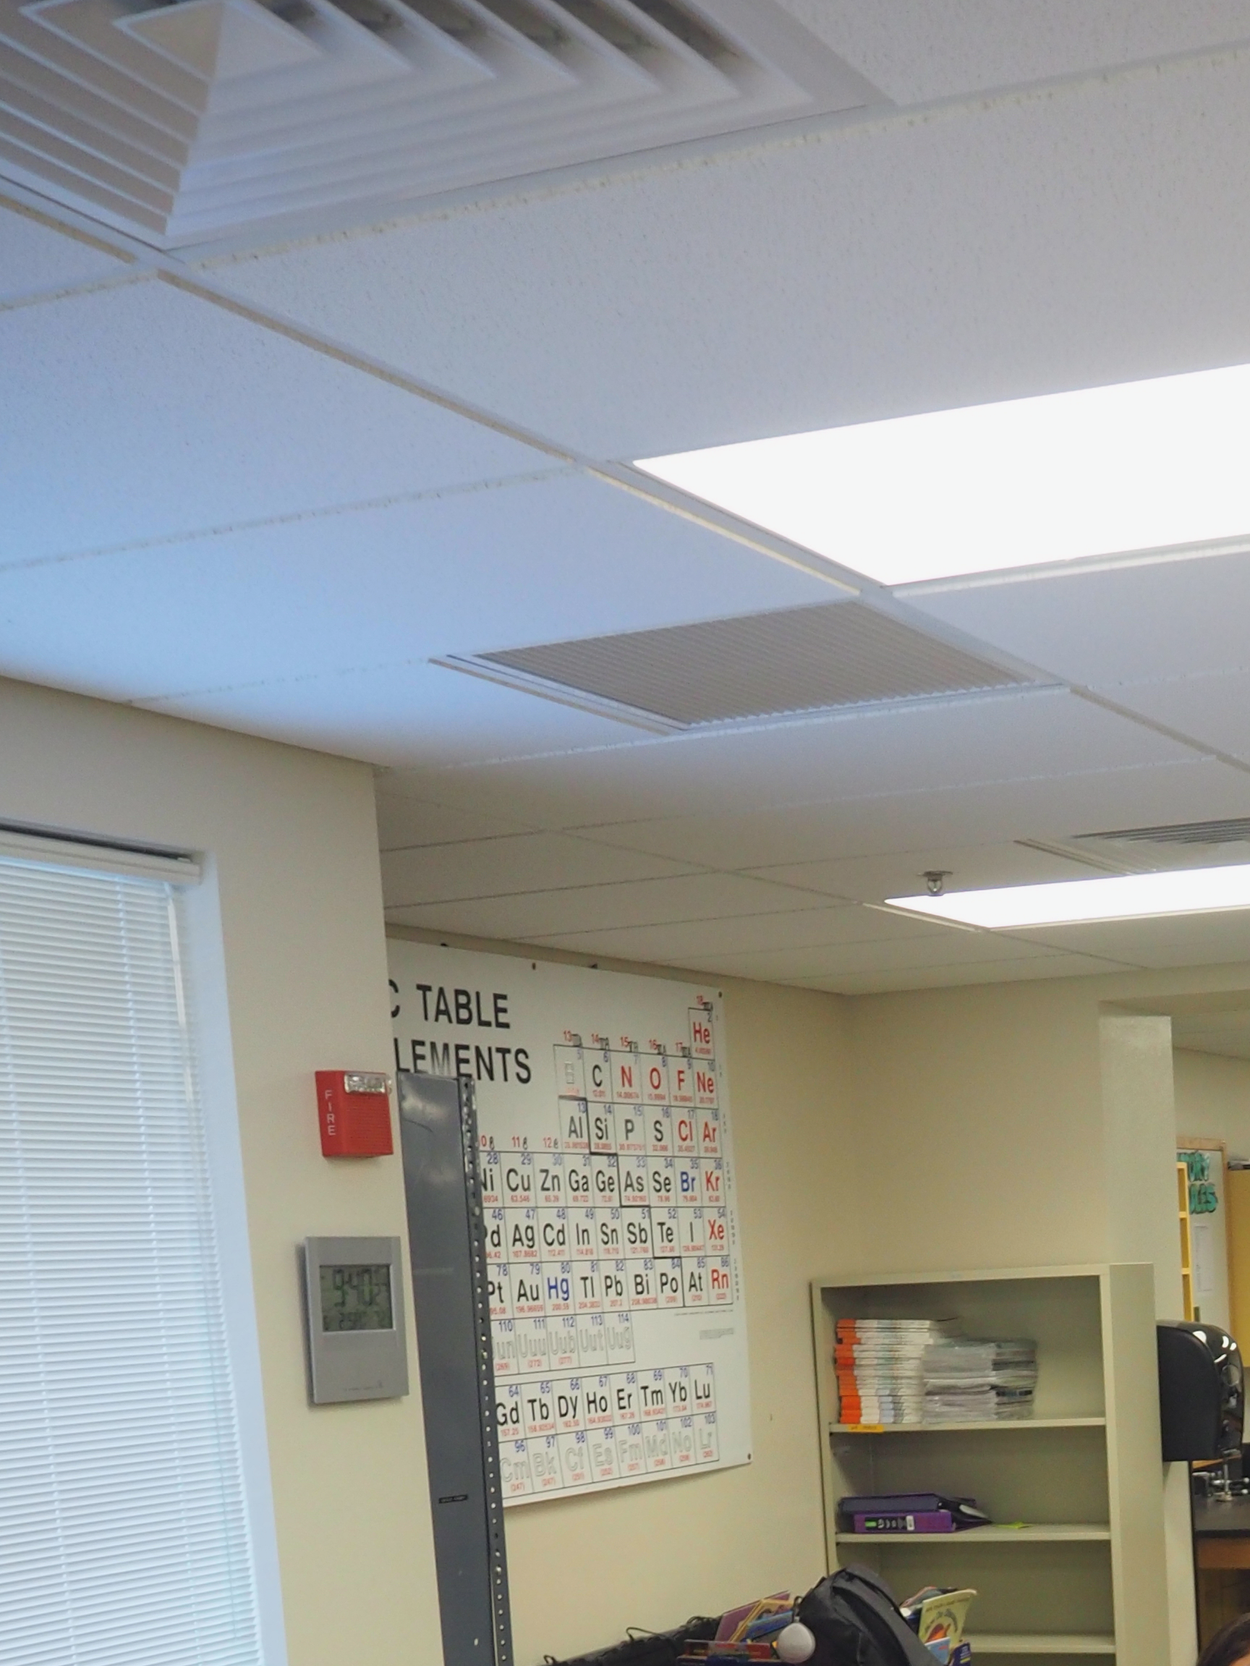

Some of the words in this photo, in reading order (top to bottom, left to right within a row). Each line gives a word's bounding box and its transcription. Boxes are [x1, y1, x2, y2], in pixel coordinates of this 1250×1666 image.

[416, 983, 510, 1029] TABLE
[693, 1022, 710, 1044] He
[592, 1065, 602, 1087] C
[621, 1066, 632, 1088] N
[650, 1067, 662, 1090] O
[678, 1070, 684, 1090] F
[696, 1072, 714, 1093] Ne
[325, 1090, 336, 1136] FIRE
[568, 1116, 582, 1138] Al
[594, 1117, 608, 1140] Si
[624, 1119, 634, 1140] P
[654, 1120, 664, 1142] S
[678, 1120, 692, 1142] Cl
[703, 1122, 717, 1143] Ar
[488, 1153, 498, 1164] 28
[521, 1154, 532, 1164] 29
[506, 1168, 530, 1192] Cu
[540, 1169, 560, 1192] Zn
[569, 1169, 589, 1192] Ga
[596, 1170, 615, 1192] Ge
[624, 1170, 644, 1192] As
[652, 1170, 672, 1192] Se
[680, 1171, 696, 1192] Br
[705, 1170, 720, 1192] Kr
[492, 1209, 502, 1220] 46
[526, 1209, 536, 1220] 47
[512, 1224, 536, 1248] Ag
[543, 1223, 566, 1246] Cd
[576, 1223, 590, 1246] In
[600, 1222, 618, 1246] Sn
[627, 1222, 648, 1244] Sb
[657, 1222, 674, 1242] Te
[690, 1222, 694, 1242] I
[708, 1220, 724, 1240] Xe
[497, 1264, 508, 1276] 78
[530, 1264, 540, 1275] 79
[711, 1269, 729, 1290] Rn
[488, 1281, 504, 1303] Pt
[517, 1280, 540, 1302] Au
[547, 1277, 570, 1301] Hg
[580, 1276, 594, 1298] Tl
[604, 1275, 623, 1296] Pb
[634, 1274, 650, 1295] Bi
[660, 1272, 678, 1293] Po
[689, 1272, 703, 1292] At
[499, 1320, 513, 1332] 110
[562, 1317, 574, 1328] 112
[550, 1330, 576, 1355] Uub
[508, 1385, 518, 1398] 64
[540, 1382, 550, 1394] 65
[616, 1388, 632, 1410] Er
[640, 1386, 664, 1406] Tm
[668, 1381, 688, 1402] Yb
[694, 1379, 710, 1400] Lu
[496, 1401, 519, 1426] Gd
[527, 1398, 549, 1421] Tb
[558, 1396, 578, 1419] Dy
[586, 1392, 608, 1414] Ho
[565, 1447, 584, 1472] Cf
[592, 1443, 613, 1466] Es
[619, 1440, 642, 1463] Fm
[500, 1457, 530, 1482] Cm
[533, 1452, 556, 1477] Bk
